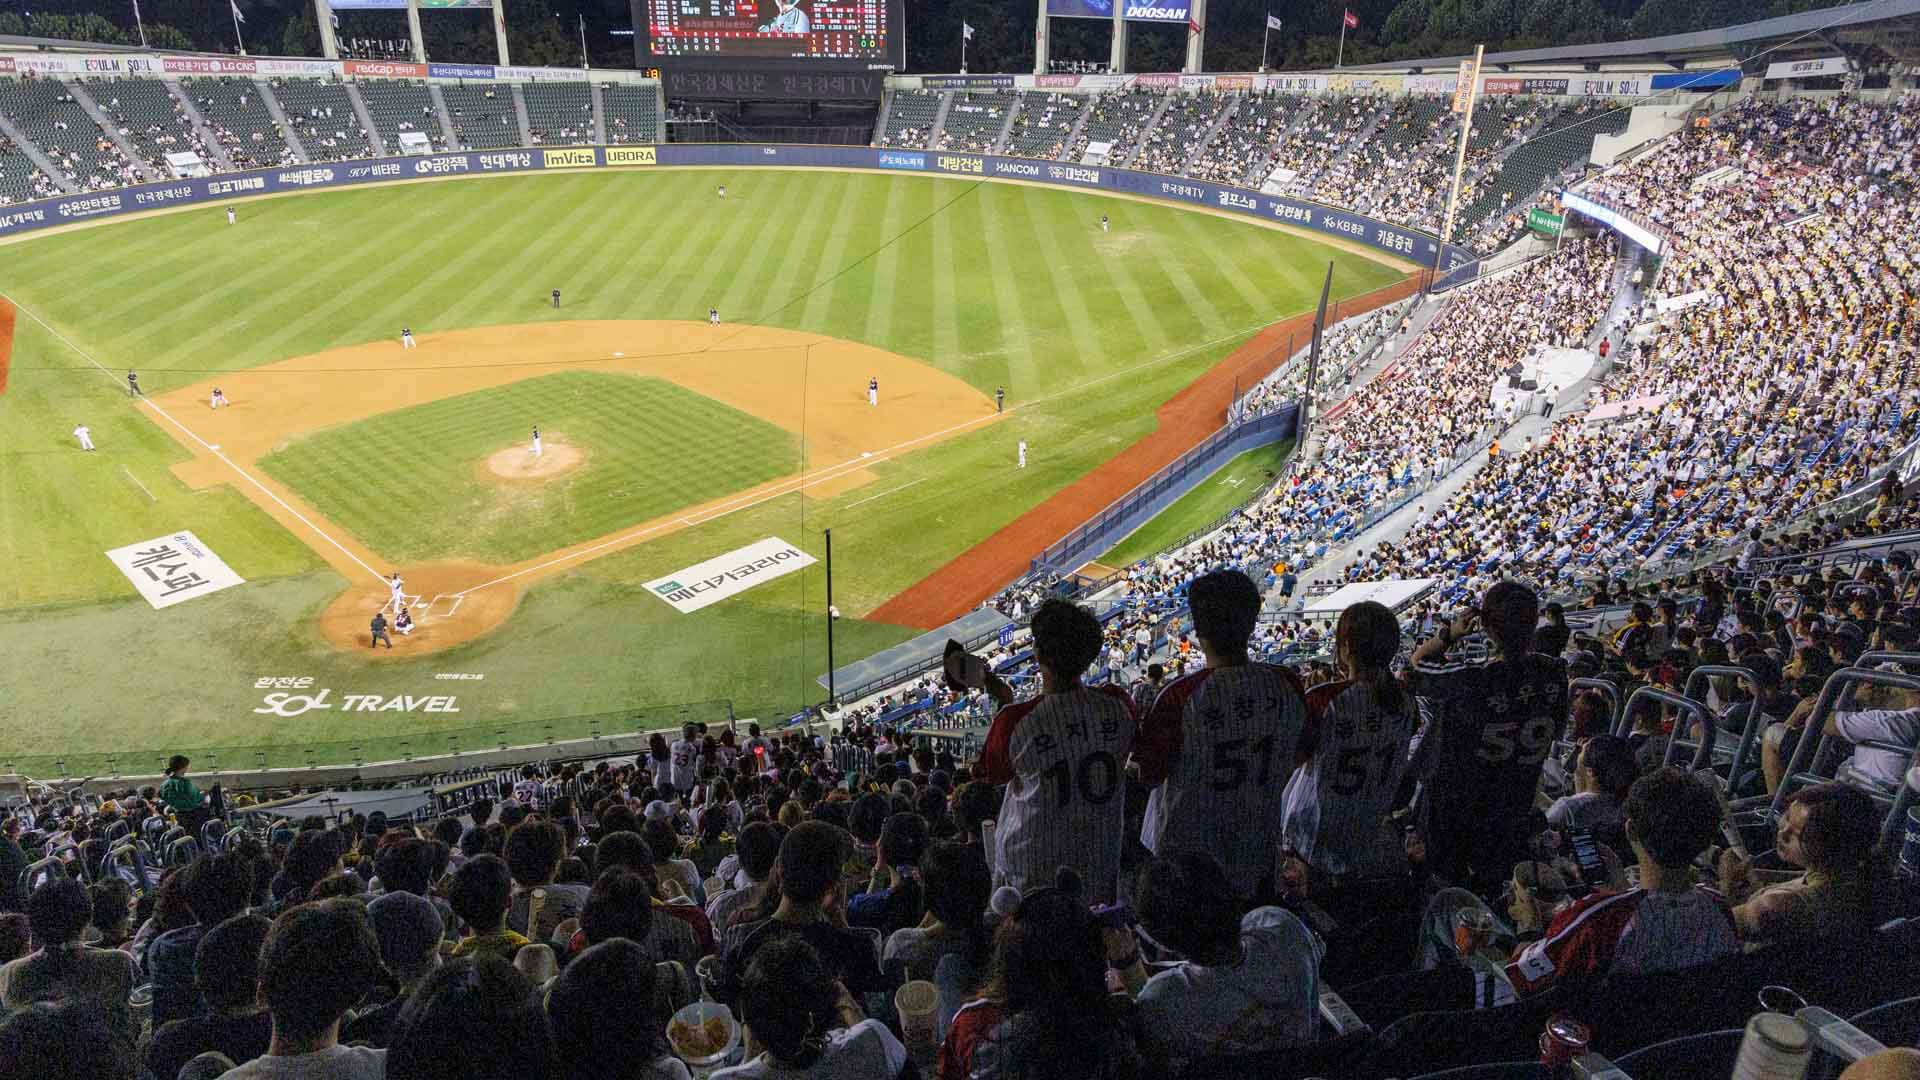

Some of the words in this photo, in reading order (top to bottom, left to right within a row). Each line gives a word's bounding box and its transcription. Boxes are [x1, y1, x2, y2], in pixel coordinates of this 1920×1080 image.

[1127, 7, 1186, 19] DOOSAN
[222, 62, 235, 71] LG
[355, 64, 393, 74] redcap
[432, 157, 468, 172] 금강주택
[480, 153, 531, 169] 현대해상
[608, 151, 654, 162] UBORA
[937, 156, 983, 172] 대방건설
[996, 162, 1039, 175] HANCOM
[136, 186, 192, 204] 한국경제신문
[1377, 229, 1414, 253] 키움증권
[131, 545, 210, 597] 캐스퍼
[666, 549, 800, 603] 메디카코리아
[254, 676, 315, 689] 환전은
[253, 689, 332, 716] SOL
[341, 695, 461, 713] TRAVEL
[1473, 716, 1555, 766] 59
[1213, 735, 1274, 791] 51
[1331, 742, 1397, 796] 51
[1046, 750, 1119, 805] 10
[517, 790, 533, 802] 22
